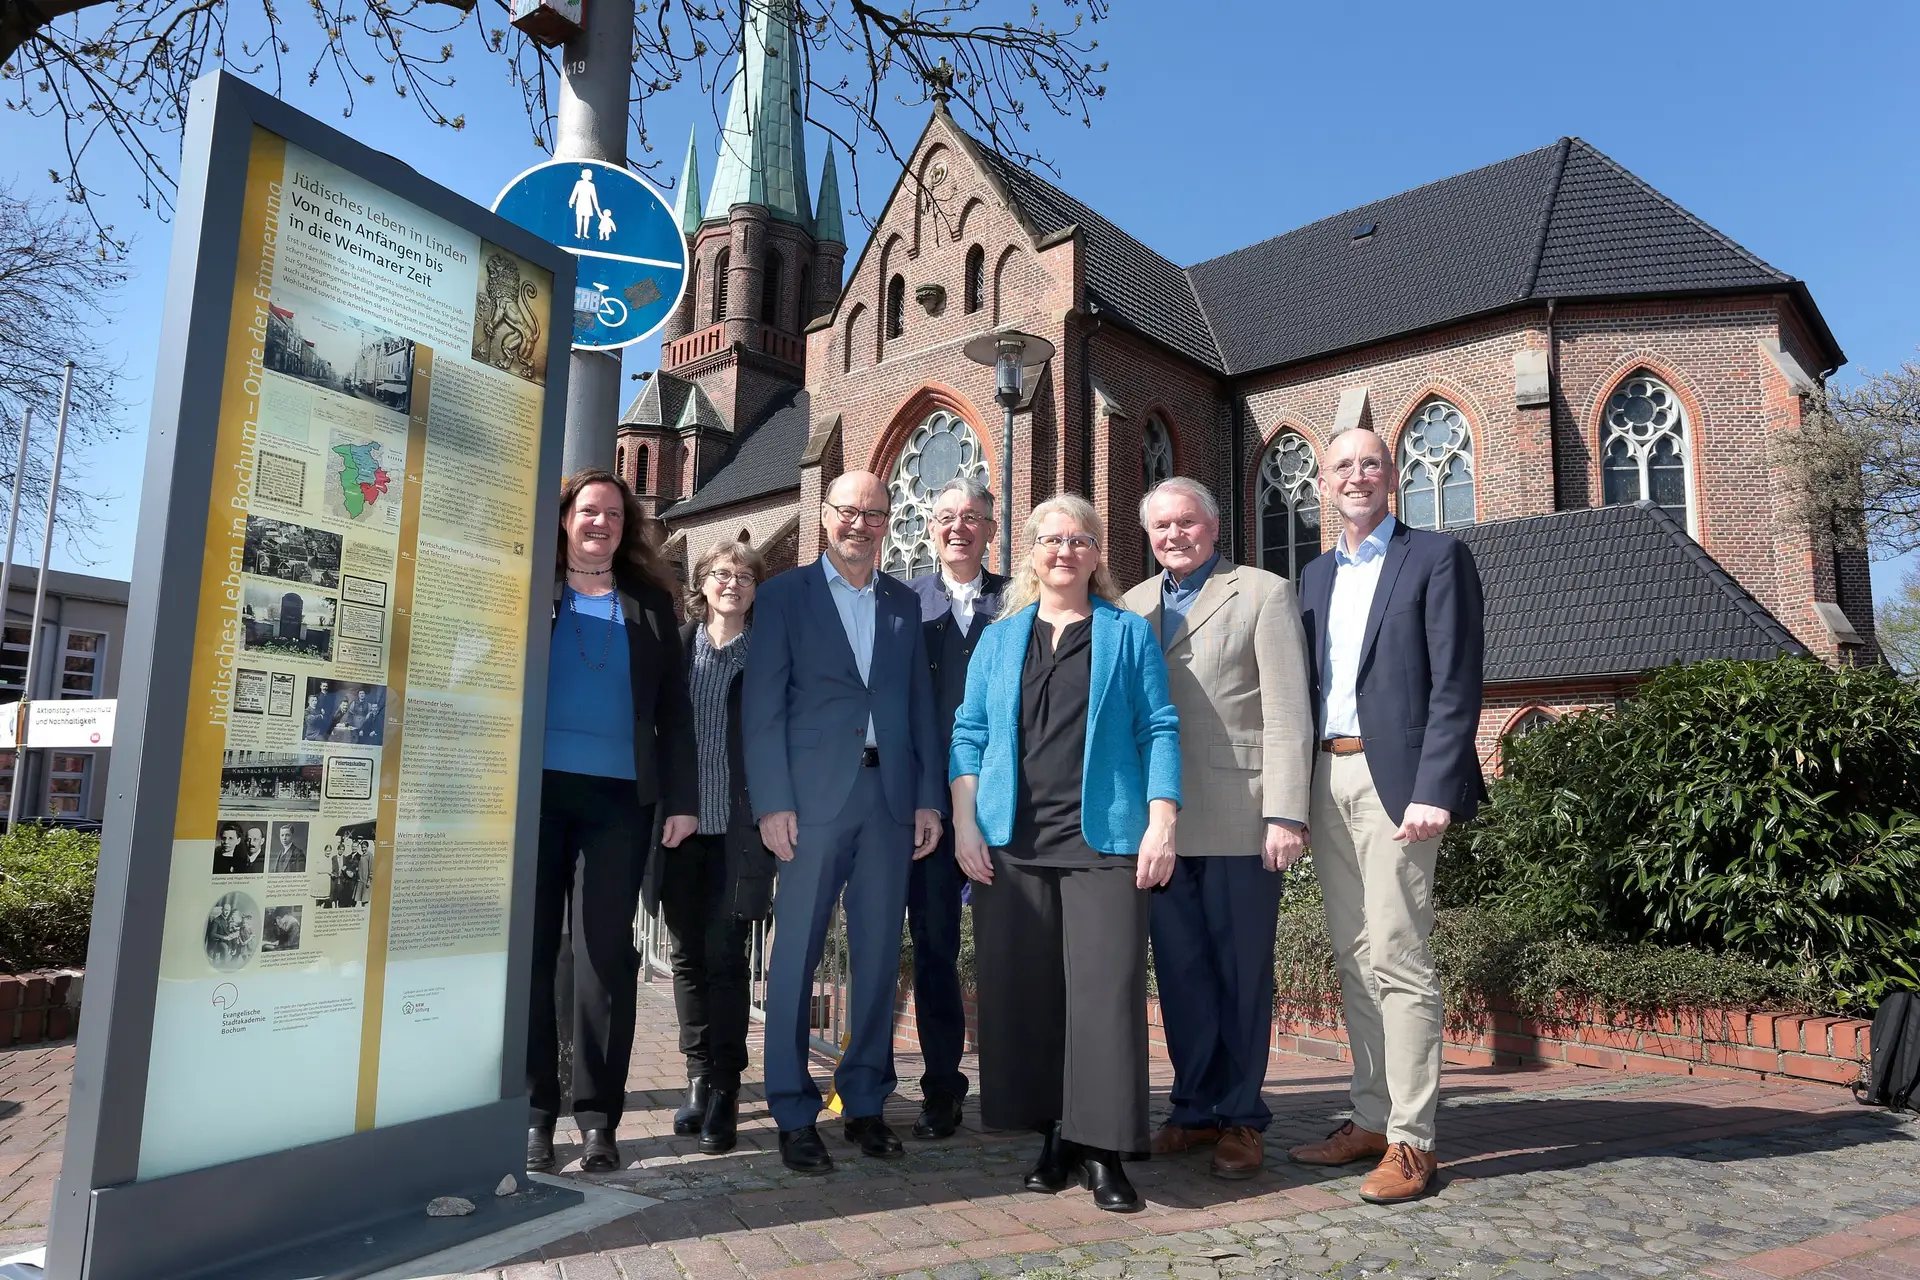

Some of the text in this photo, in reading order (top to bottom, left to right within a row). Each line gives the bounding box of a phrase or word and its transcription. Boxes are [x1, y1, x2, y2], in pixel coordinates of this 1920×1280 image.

[254, 182, 282, 302] Erinnerung
[290, 191, 442, 272] Von den Anfängen bis
[292, 170, 467, 264] Jüdisches Leben in Linden
[288, 212, 432, 287] in die Weimarer Zeit
[248, 305, 269, 342] der
[244, 348, 264, 396] Orte
[231, 420, 256, 511] Bochum
[228, 518, 246, 538] in
[221, 546, 244, 610] Leben
[209, 618, 236, 728] Jüdisches
[49, 717, 96, 726] Nachhaltigkeit
[222, 1009, 260, 1018] Evangelische
[222, 1016, 265, 1026] Stadtakademie
